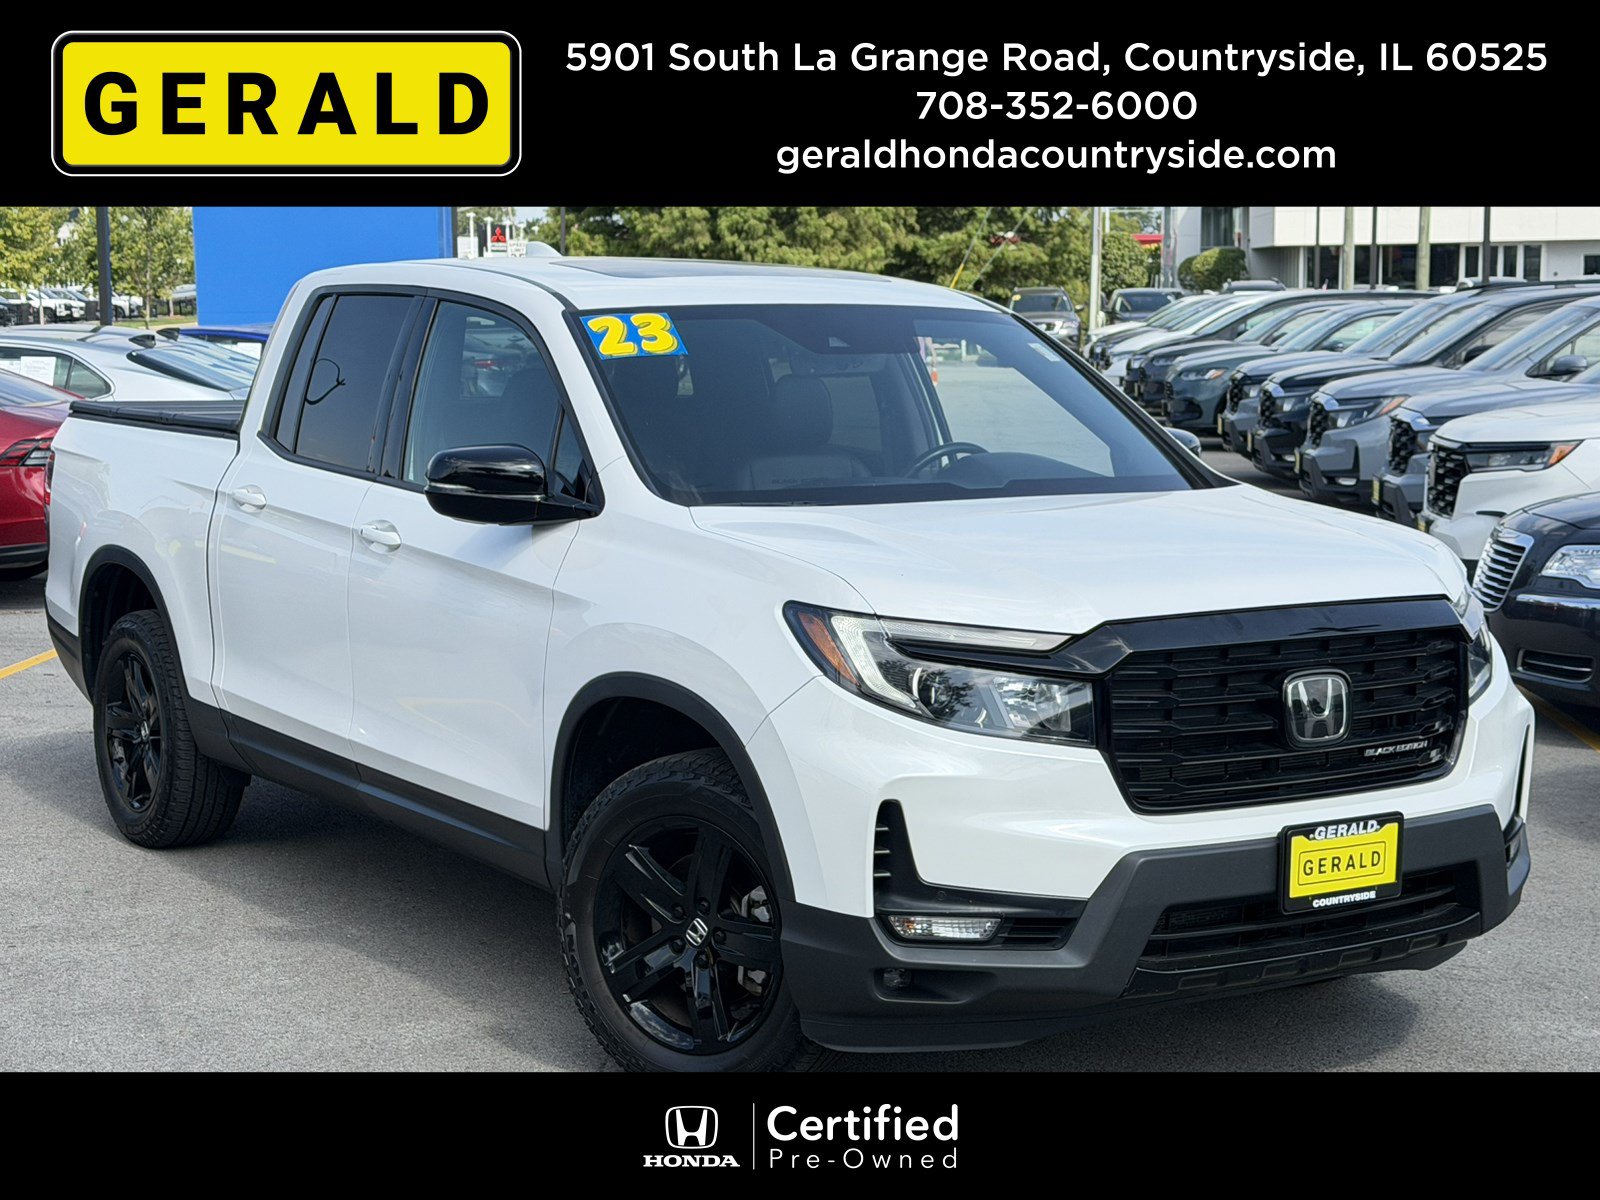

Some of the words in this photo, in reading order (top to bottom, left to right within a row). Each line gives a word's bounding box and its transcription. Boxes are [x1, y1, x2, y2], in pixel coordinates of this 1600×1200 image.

[587, 313, 678, 356] 23
[1363, 745, 1396, 757] BLACK
[1314, 820, 1378, 840] GERALD
[1303, 851, 1381, 876] GERALD
[1312, 890, 1376, 908] COUNTRYSIDE
